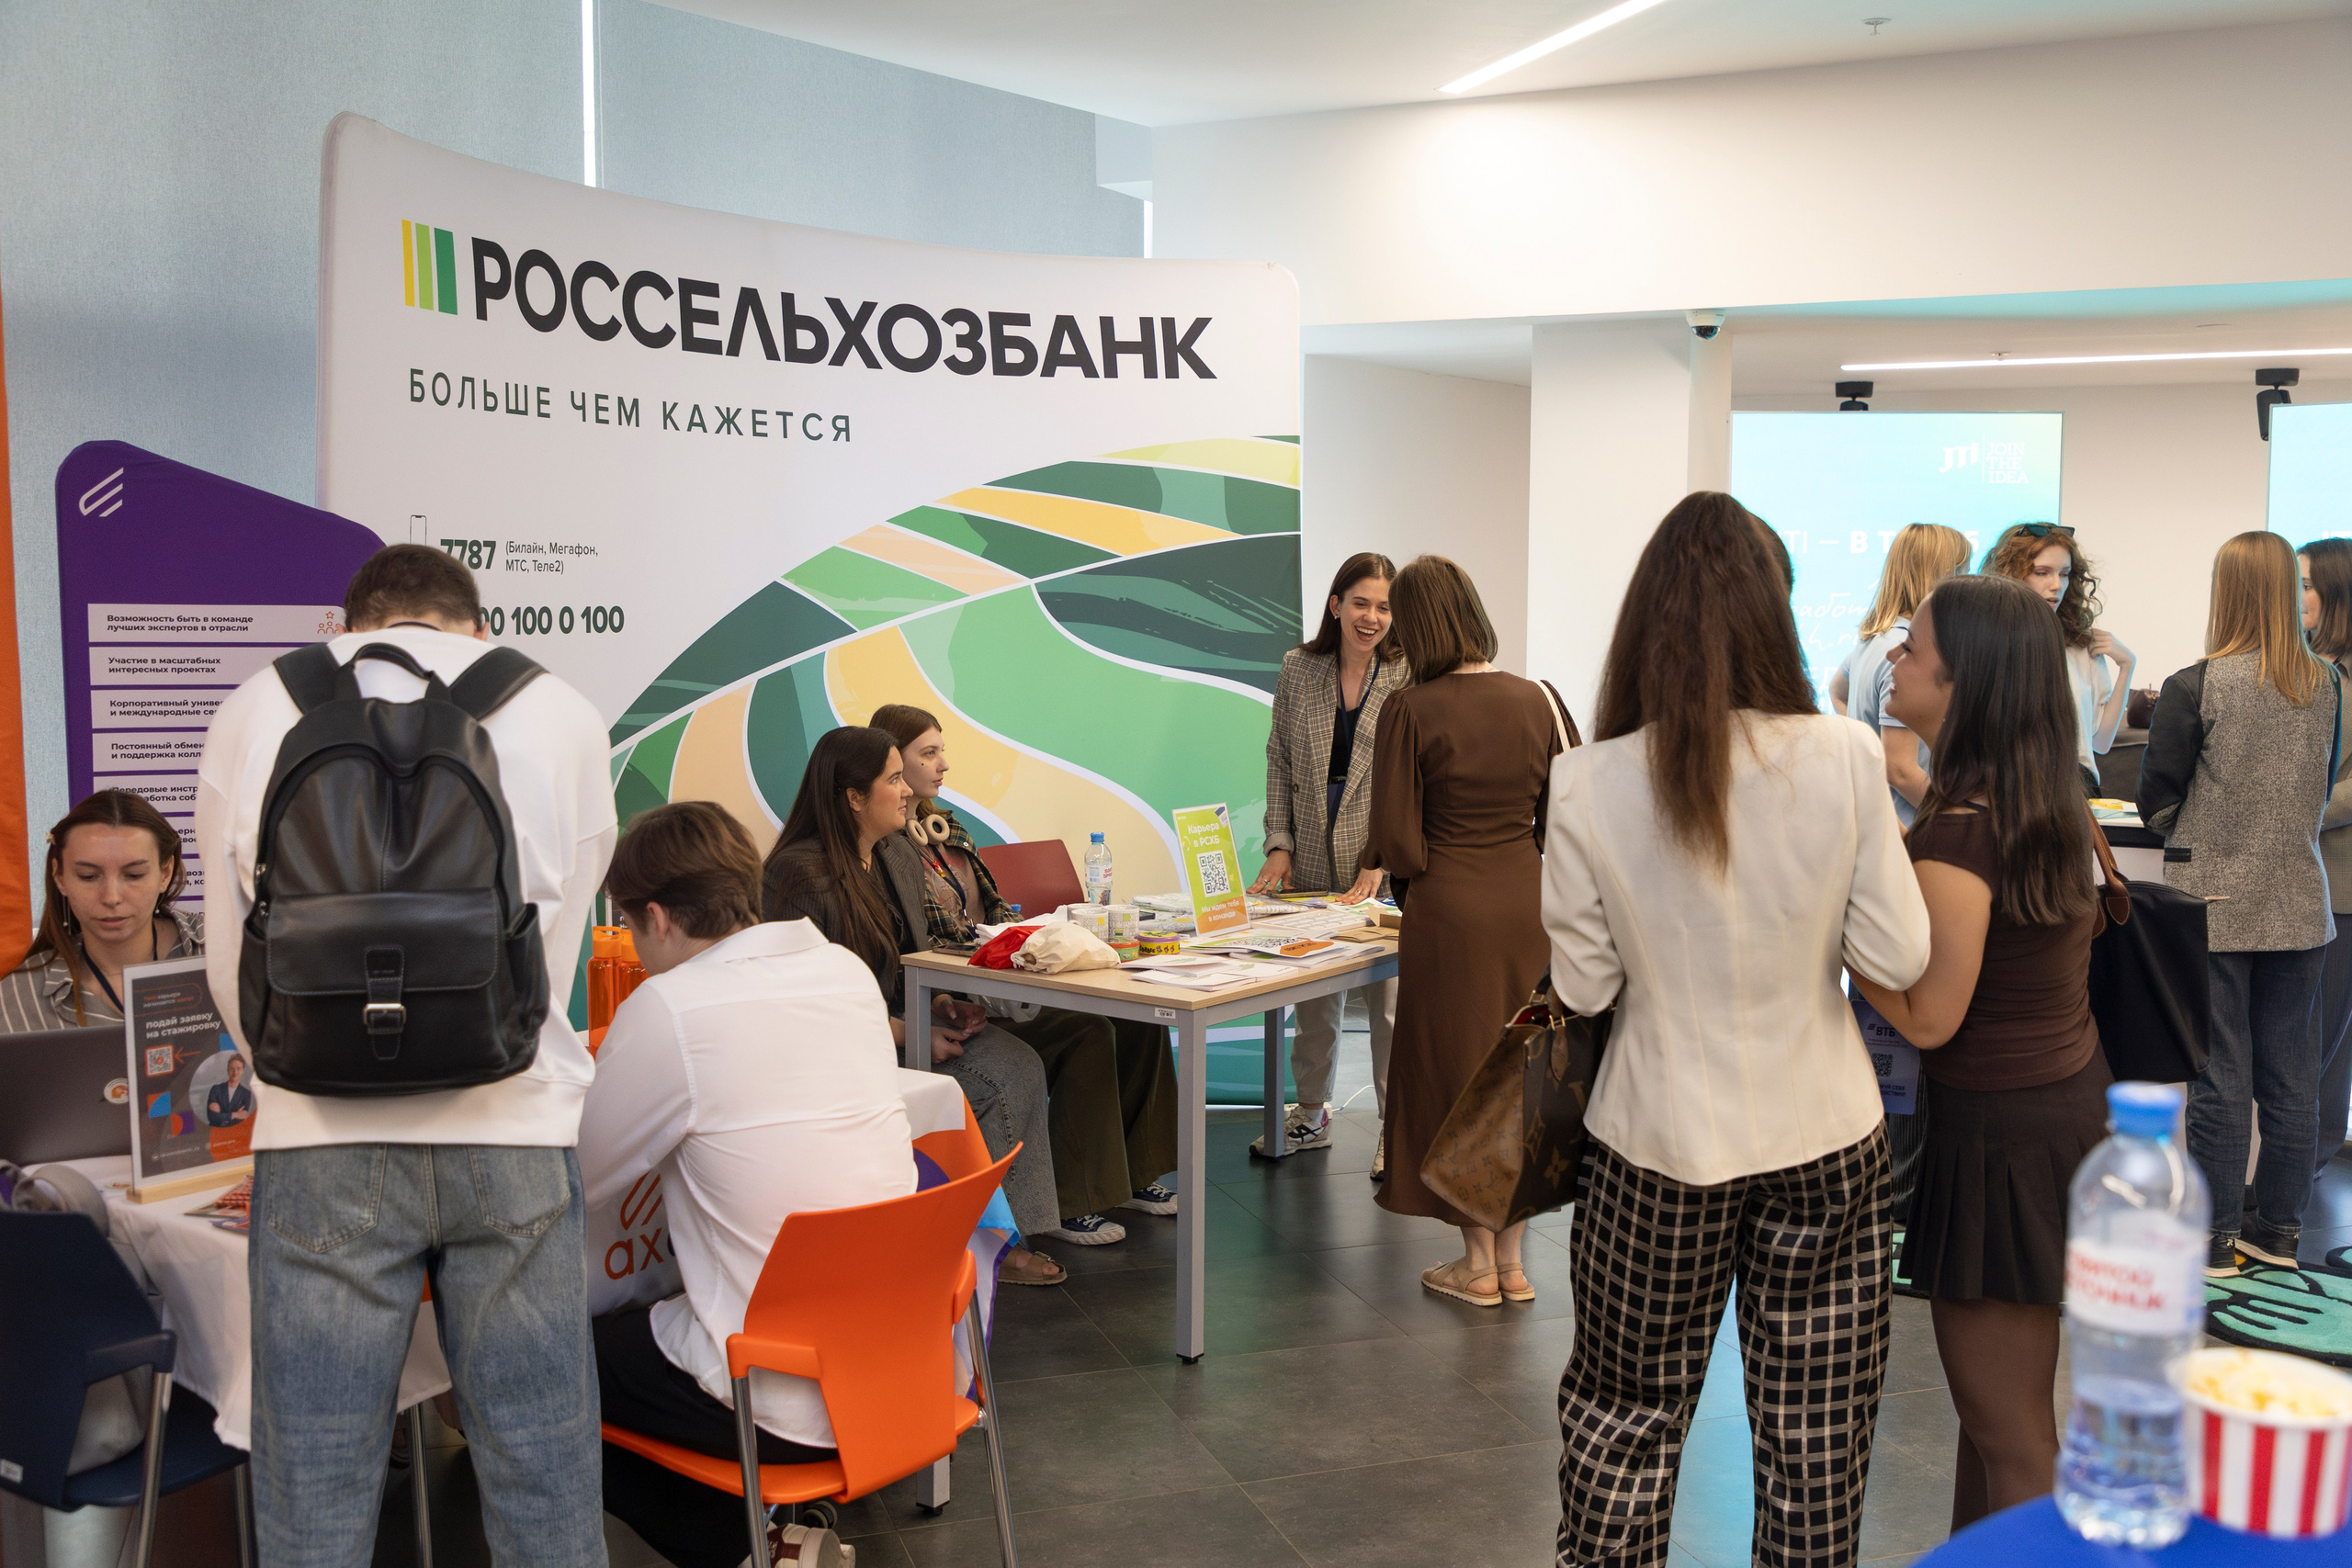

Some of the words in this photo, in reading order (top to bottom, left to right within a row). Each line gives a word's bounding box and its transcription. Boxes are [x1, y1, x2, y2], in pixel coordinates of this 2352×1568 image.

[471, 236, 1217, 379] РОССЕЛЬХОЗБАНК
[409, 368, 551, 419] БОЛЬШЕ
[571, 390, 640, 428] ЧЕМ
[662, 401, 852, 443] КАЖЕТСЯ
[1987, 442, 2027, 456] JOIN
[1986, 457, 2022, 470] THE
[1988, 470, 2030, 484] IDEA
[1779, 531, 1807, 553] TI
[440, 538, 497, 570] 7787
[505, 541, 547, 556] (Билайн,
[549, 542, 598, 558] Мегафон,
[505, 559, 529, 573] МТС,
[532, 559, 564, 574] Теле2)
[107, 615, 175, 623] Возможность
[176, 615, 201, 623] быть
[511, 606, 553, 635] 100
[560, 606, 574, 634] 0
[581, 606, 625, 634] 100
[109, 699, 188, 708] Корпоративный
[111, 742, 172, 750] Постоянный
[170, 785, 198, 794] инстр
[178, 794, 197, 802] соб
[1187, 822, 1220, 835] Карьера
[1193, 839, 1199, 848] в
[1199, 835, 1220, 846] РСХБ
[146, 1016, 177, 1029] подай
[180, 1012, 213, 1023] заявку
[146, 1031, 159, 1039] на
[161, 1021, 221, 1036] стажировку
[1876, 1027, 1895, 1037] ВТБ
[605, 1227, 664, 1280] ax
